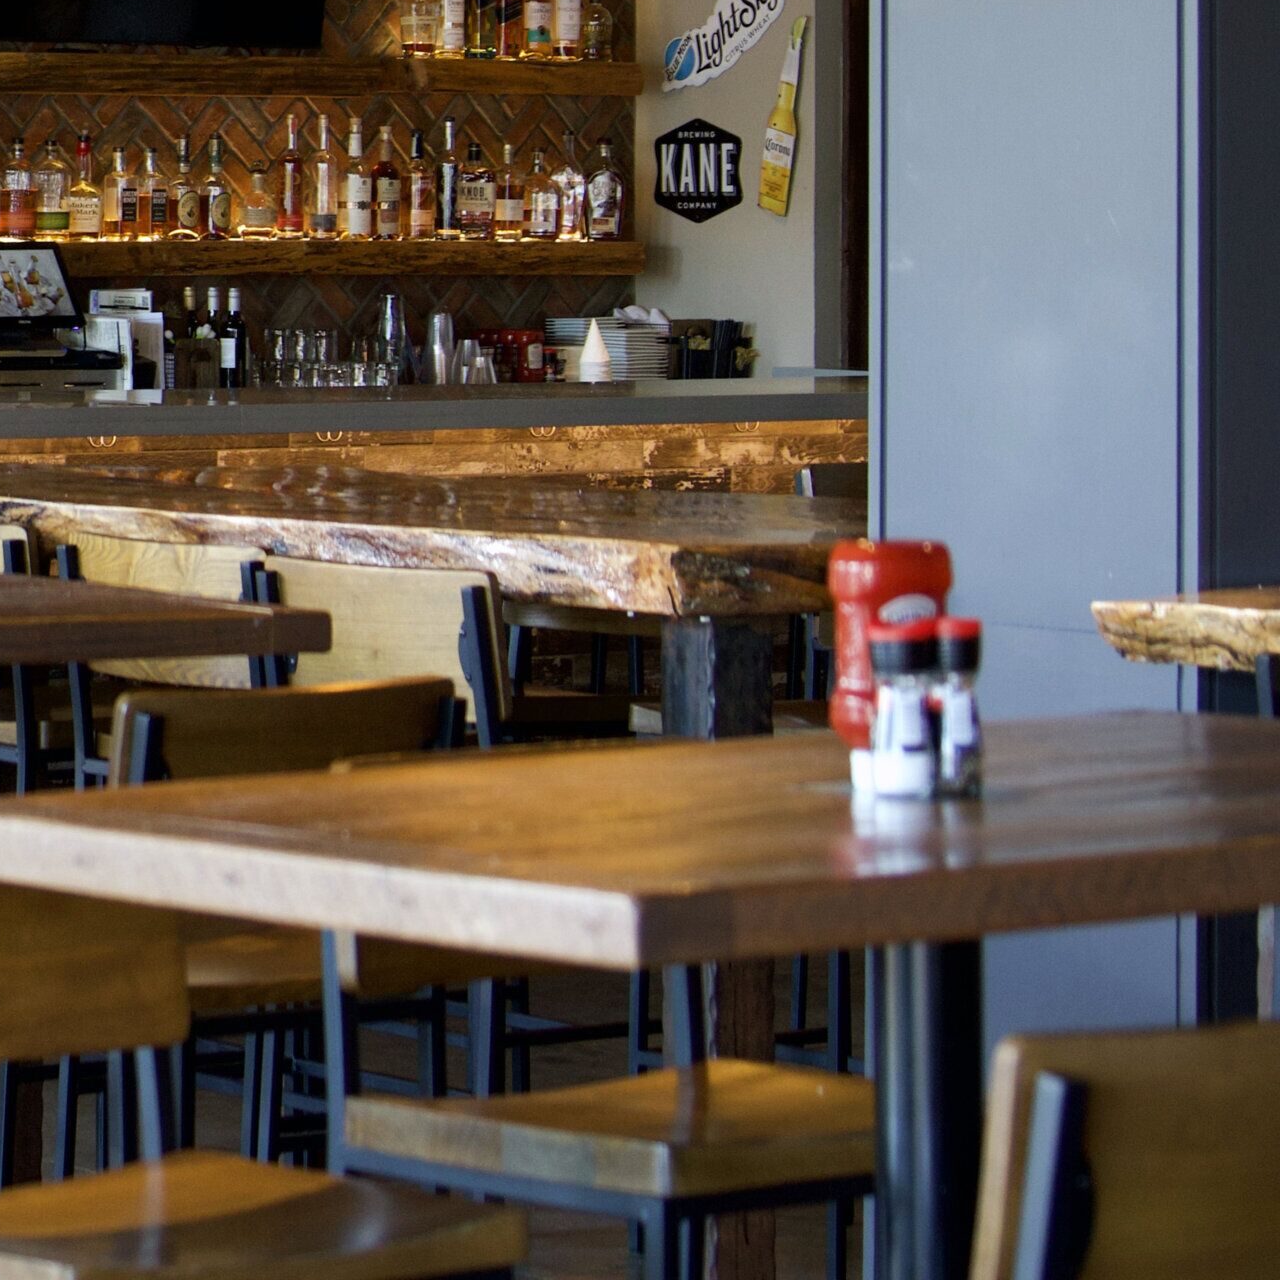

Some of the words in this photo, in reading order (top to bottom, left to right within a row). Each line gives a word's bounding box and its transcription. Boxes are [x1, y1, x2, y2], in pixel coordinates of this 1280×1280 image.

[724, 38, 749, 63] CITRUS
[748, 14, 771, 40] WHEAT
[665, 55, 681, 82] BLUE
[676, 34, 693, 58] MOON
[677, 130, 716, 139] BREWING
[765, 137, 791, 156] Corona
[661, 142, 736, 196] KANE
[460, 186, 485, 198] KNOB
[676, 201, 718, 210] COMPANY
